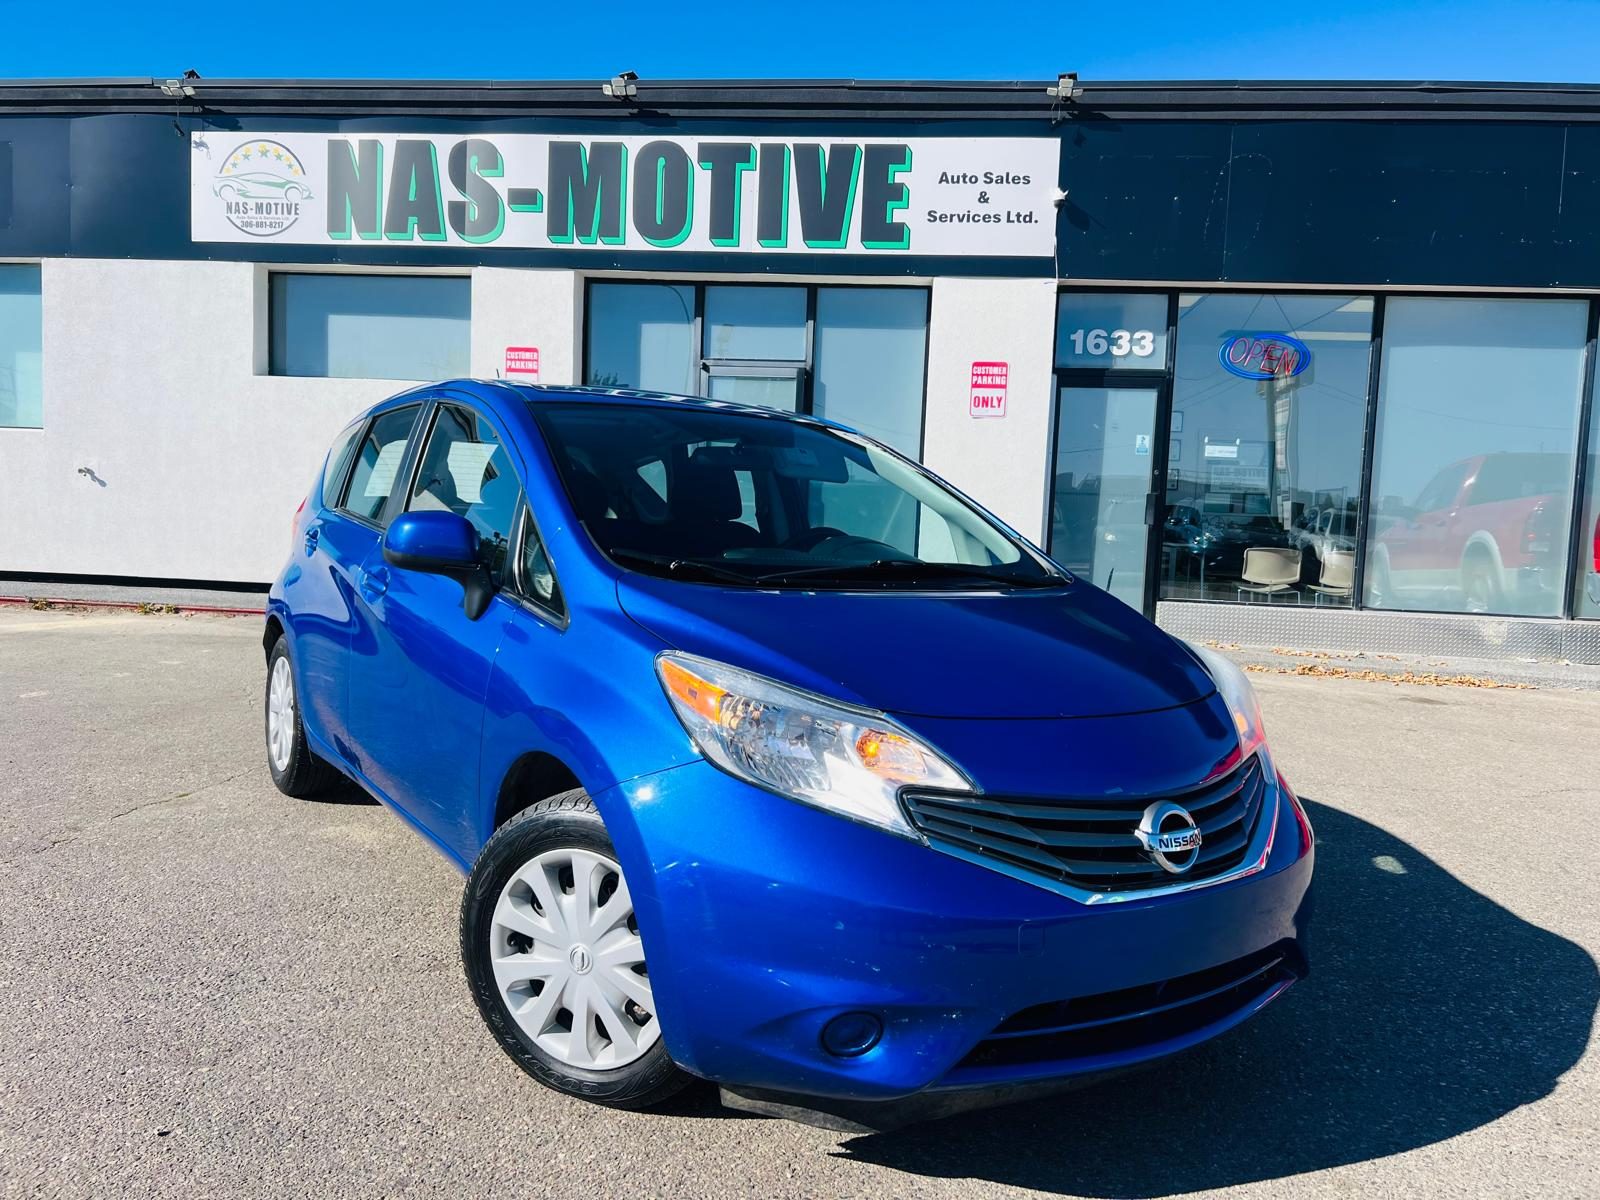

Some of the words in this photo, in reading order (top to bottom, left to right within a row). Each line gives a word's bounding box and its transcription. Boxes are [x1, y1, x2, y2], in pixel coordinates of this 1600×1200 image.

[938, 171, 979, 185] Auto
[983, 171, 1031, 186] Sales
[327, 139, 913, 250] NAS-MOTIVE
[977, 191, 990, 204] &
[226, 201, 300, 216] NAS-MOTIVE
[927, 210, 1002, 223] Services
[1006, 210, 1039, 224] Ltd.
[1070, 329, 1154, 357] 1633
[1229, 337, 1297, 376] OPEN
[506, 360, 538, 369] PARKING
[973, 366, 1007, 375] CUSTOMER
[972, 375, 1007, 385] PARKING
[973, 395, 1003, 408] ONLY
[1158, 834, 1201, 849] NISSAN
